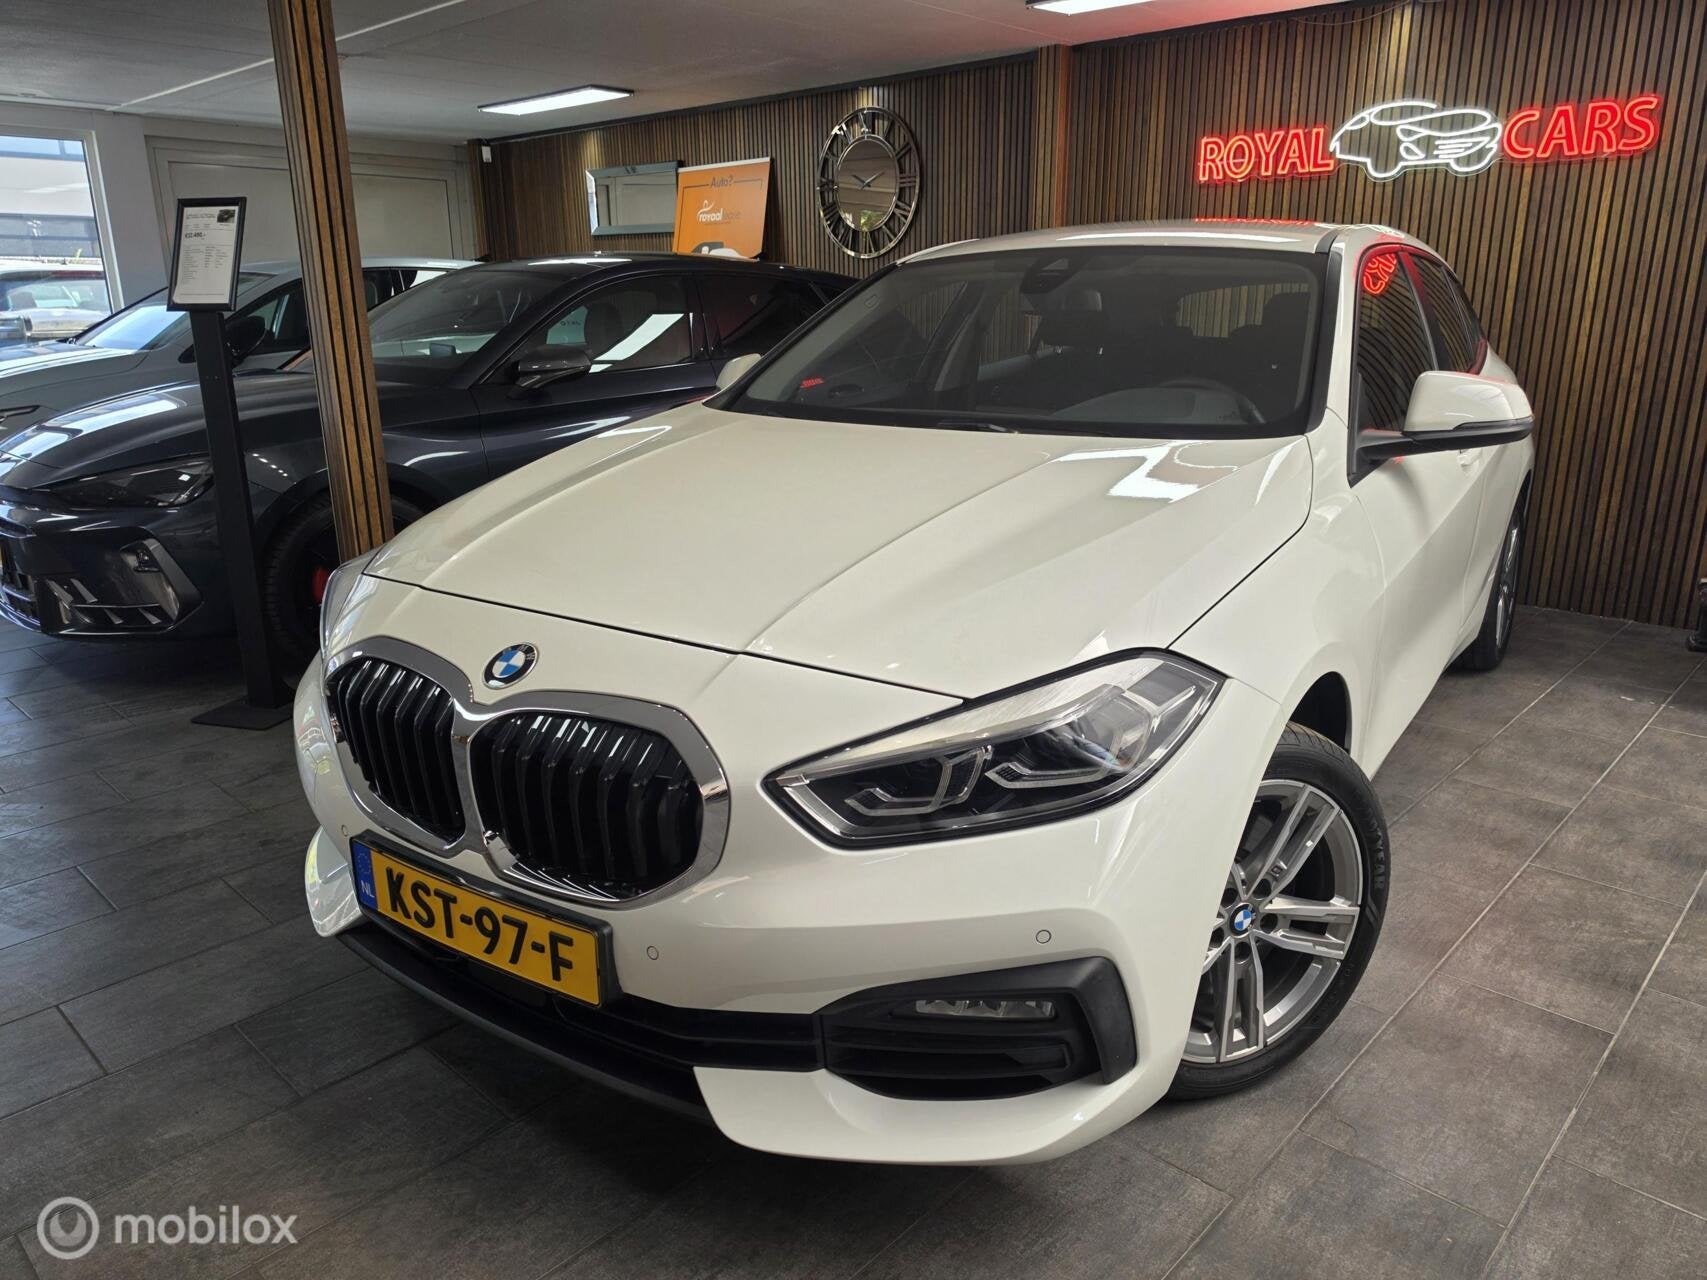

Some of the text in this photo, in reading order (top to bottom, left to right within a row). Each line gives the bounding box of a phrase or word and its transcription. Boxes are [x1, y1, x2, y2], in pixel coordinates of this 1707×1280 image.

[1199, 96, 1658, 181] ROYAL CARS
[710, 174, 734, 188] Auto?
[360, 879, 375, 898] NL
[386, 866, 574, 982] KST-97-F
